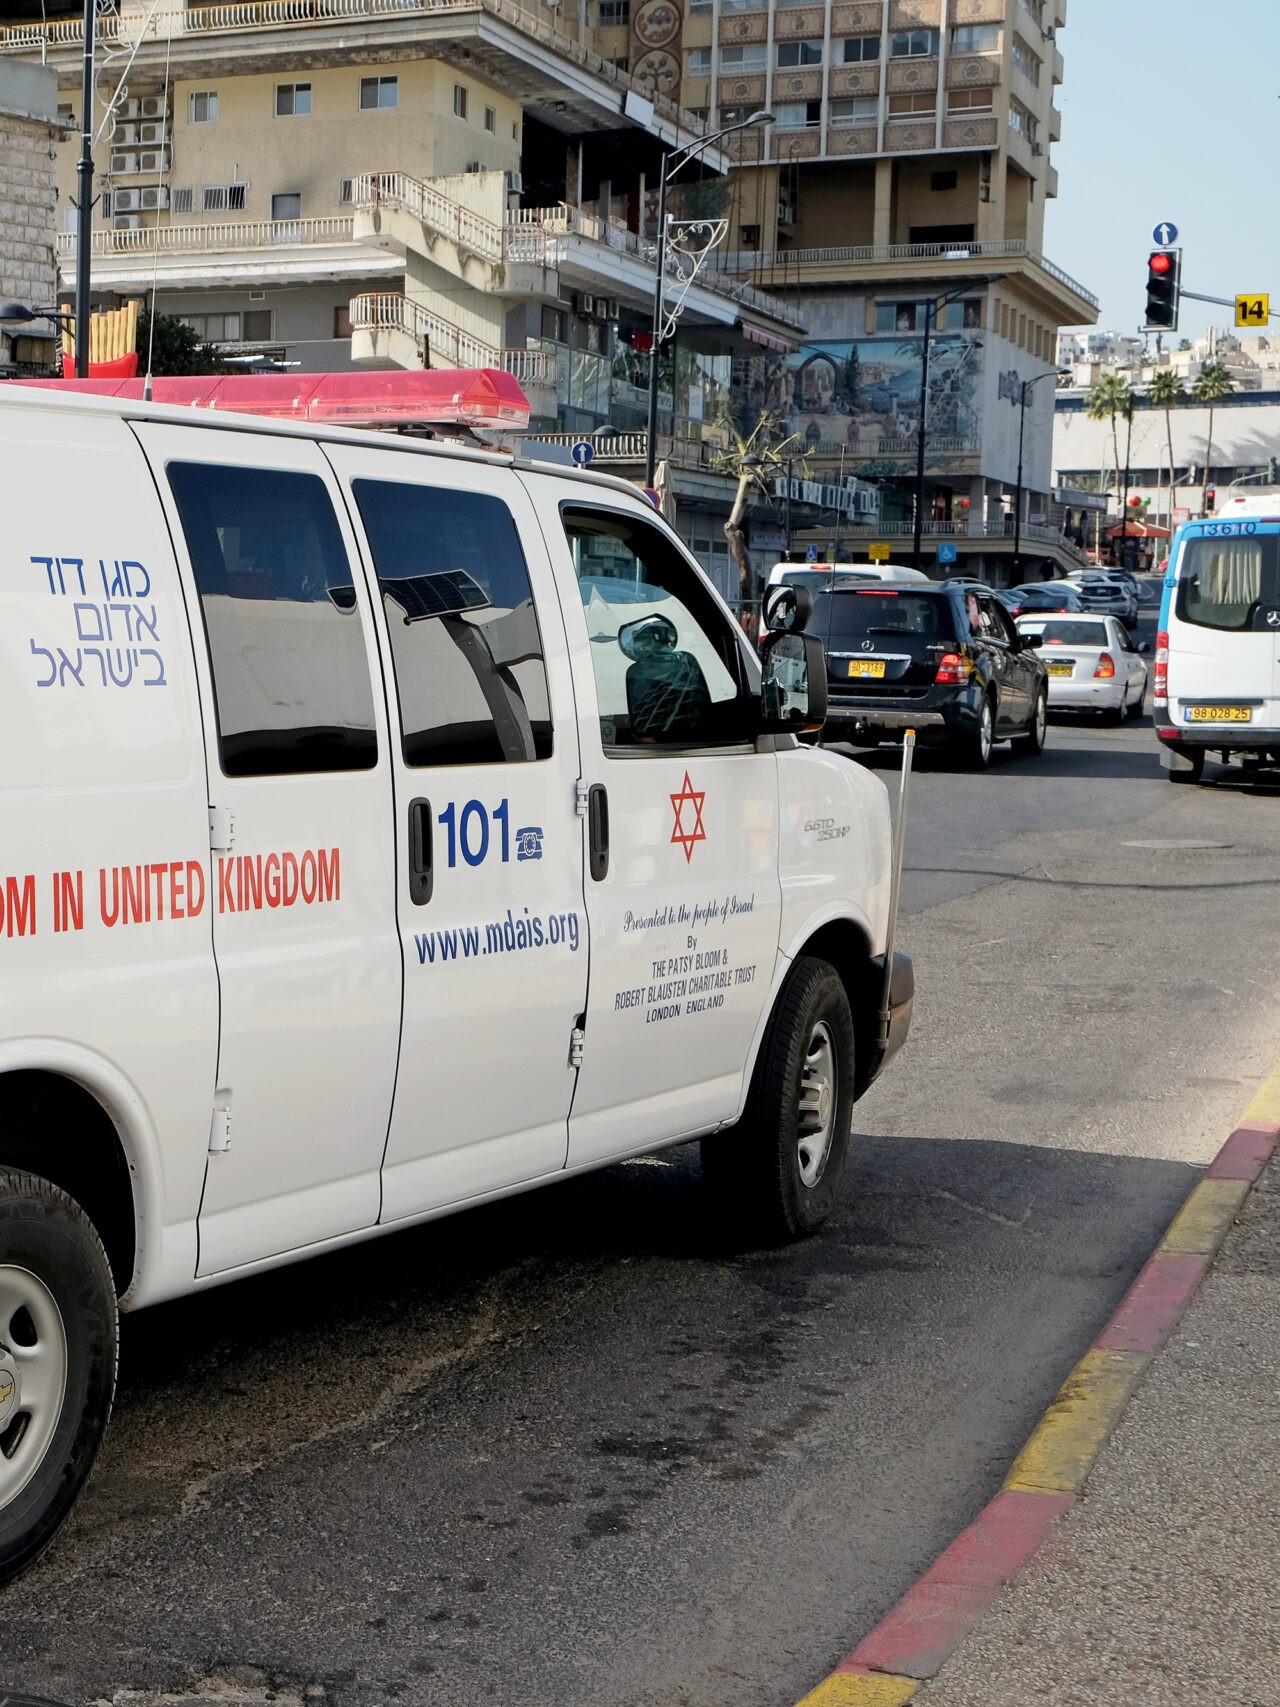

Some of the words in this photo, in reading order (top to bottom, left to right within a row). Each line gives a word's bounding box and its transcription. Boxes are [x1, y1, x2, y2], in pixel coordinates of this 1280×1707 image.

[1238, 300, 1264, 320] 14
[1200, 522, 1257, 535] 13610
[30, 555, 87, 596] דוד
[99, 559, 151, 602] מגן
[73, 602, 161, 642] אדום
[30, 638, 168, 687] בישראל
[438, 798, 510, 868] 101
[53, 871, 84, 933] IN
[99, 860, 205, 928] UNITED
[218, 848, 341, 913] KINGDOM
[623, 906, 667, 932] Presented
[691, 899, 719, 928] people
[729, 892, 755, 915] Israel
[415, 907, 580, 965] www.mdais.org
[687, 935, 698, 951] By
[652, 960, 667, 979] THE
[668, 955, 694, 976] PATSY
[695, 949, 721, 971] BLOOM
[722, 948, 729, 965] &
[614, 987, 646, 1011] ROBERT
[647, 979, 687, 1004] BLAUSTEN
[688, 969, 733, 995] CHARITABLE
[734, 965, 757, 985] TRUST
[646, 1003, 682, 1023] LONDON
[686, 994, 725, 1015] ENGLAND
